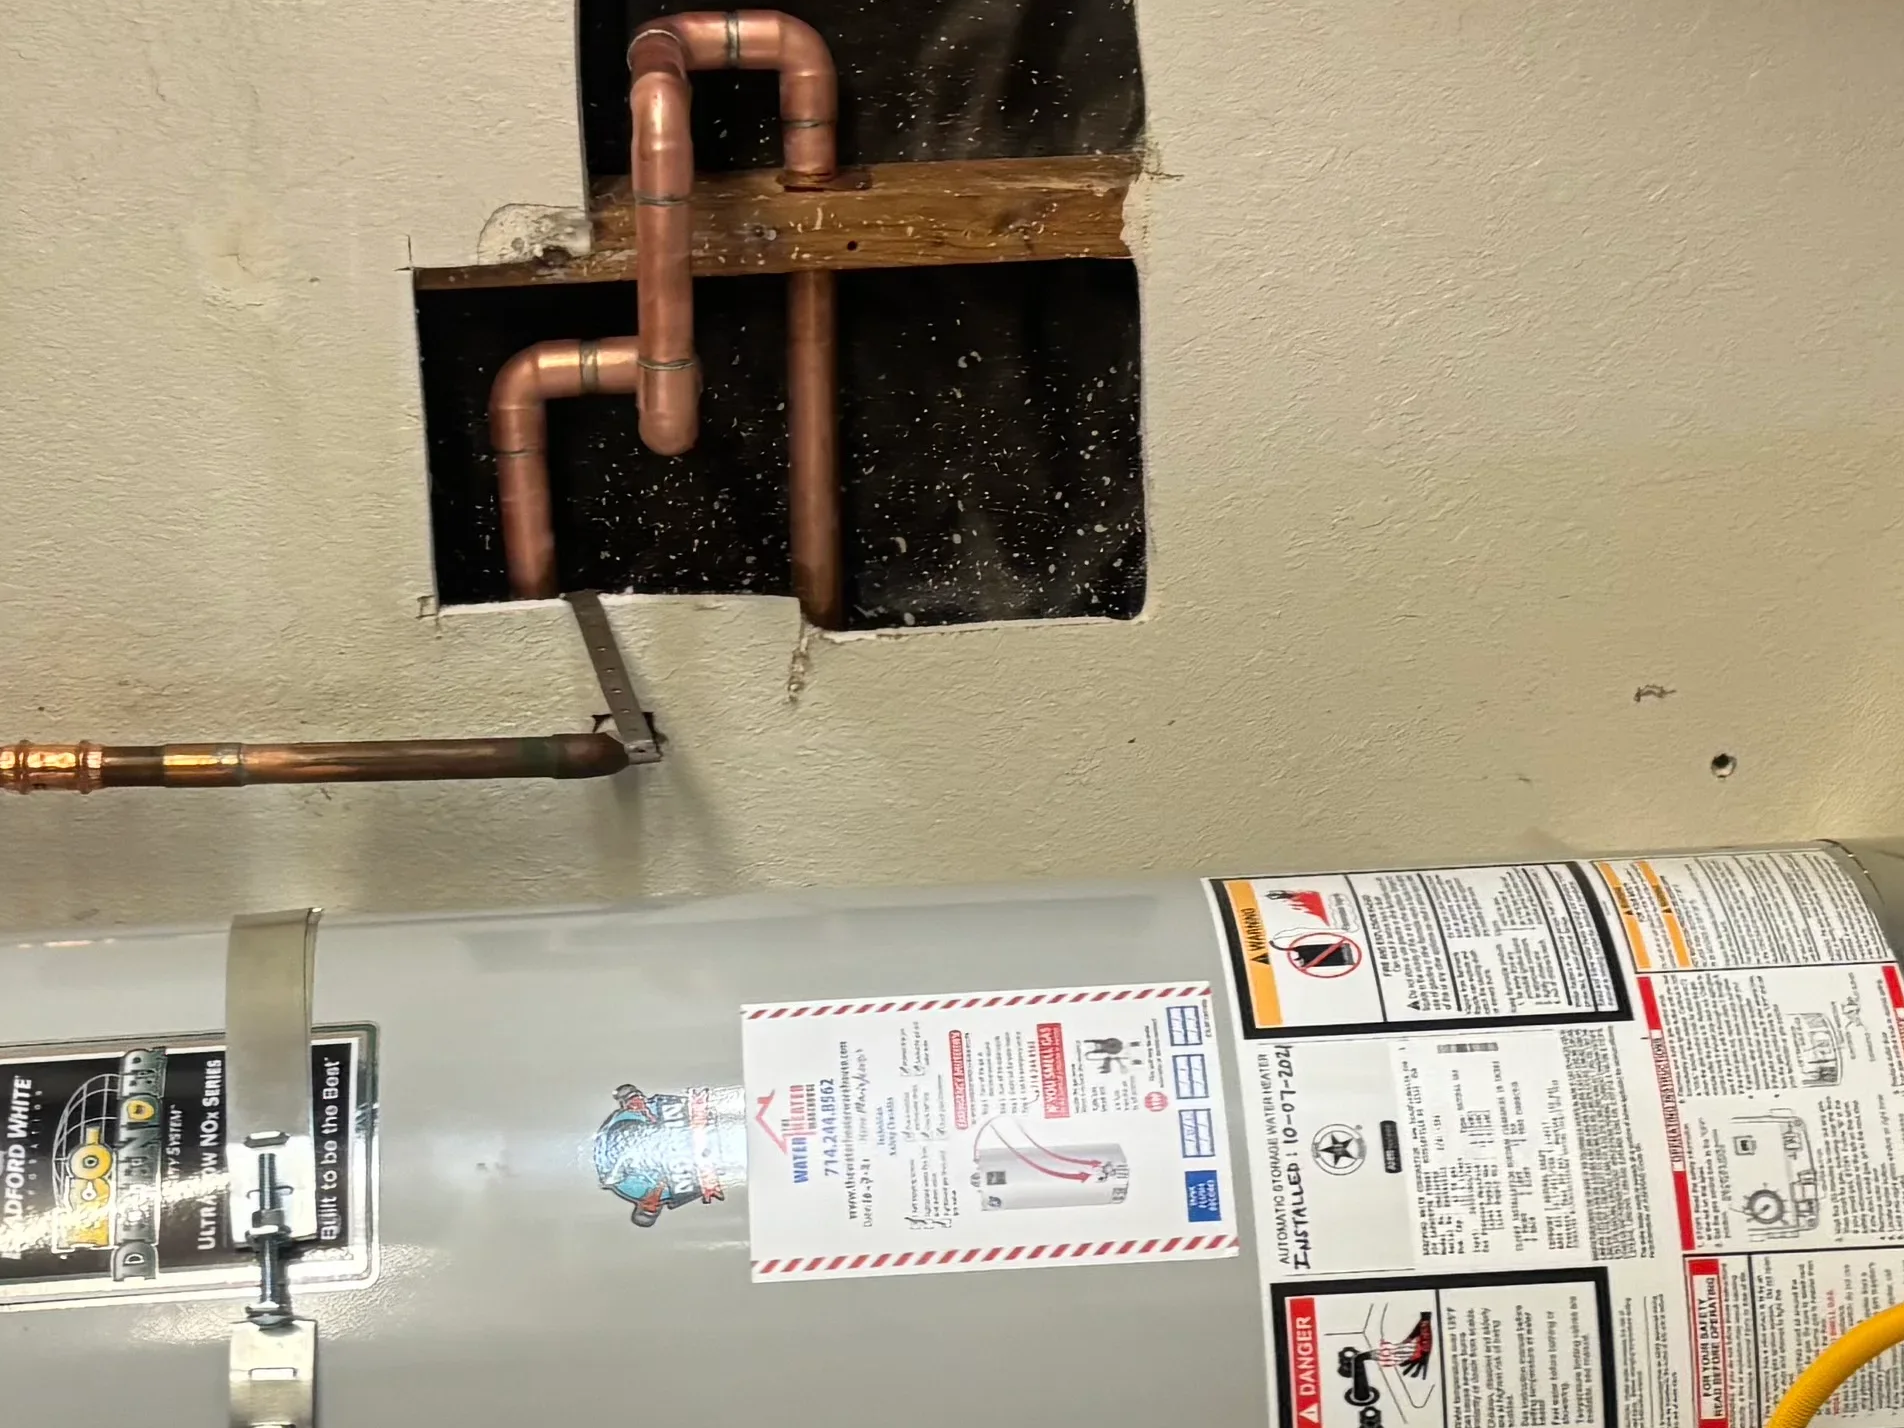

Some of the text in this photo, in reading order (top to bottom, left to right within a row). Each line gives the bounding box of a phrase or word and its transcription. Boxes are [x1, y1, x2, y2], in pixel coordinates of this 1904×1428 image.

[1240, 907, 1265, 951] WARNING
[321, 1105, 339, 1134] the
[789, 1084, 809, 1184] WATER HEATER
[1274, 1044, 1299, 1144] 10-07-2021
[2, 1078, 32, 1259] ADFORD WHITE
[110, 1047, 168, 1281] DEENDER
[199, 1152, 217, 1188] OW
[320, 1140, 338, 1164] be
[1257, 1054, 1291, 1265] AUTOMATIC STORAGE WATER HEATER
[1665, 1105, 1683, 1164] OPERATING
[318, 1196, 339, 1240] Built
[321, 1170, 338, 1190] to
[1295, 1316, 1317, 1396] DANGER
[1697, 1298, 1713, 1397] FOR YOUR SAFETY
[1706, 1277, 1723, 1417] READ BEFORE OPERATING
